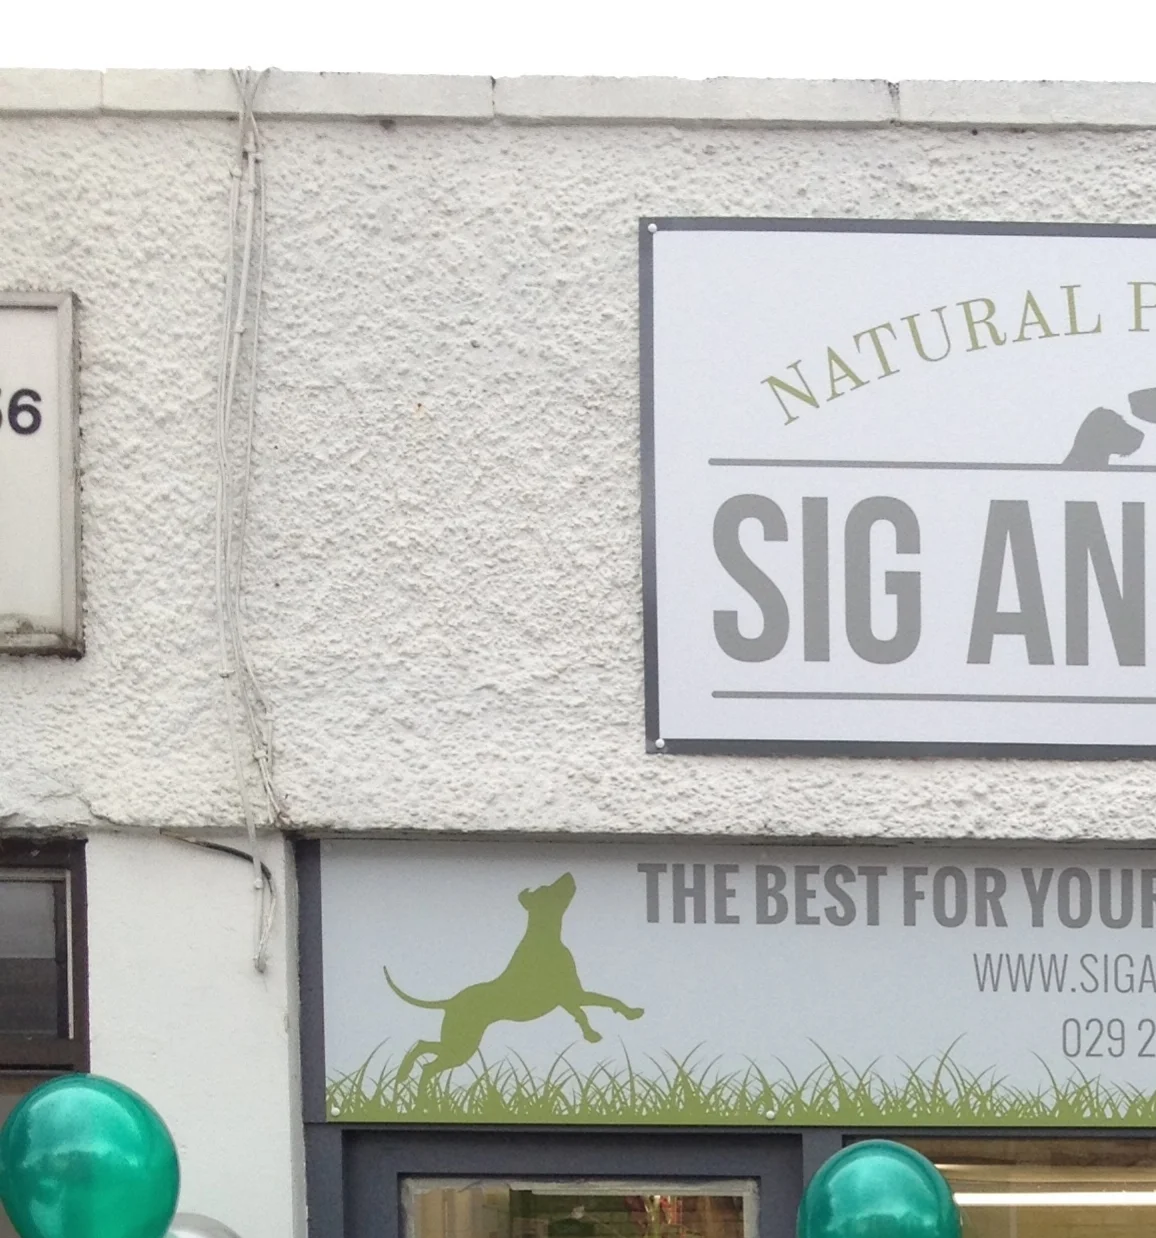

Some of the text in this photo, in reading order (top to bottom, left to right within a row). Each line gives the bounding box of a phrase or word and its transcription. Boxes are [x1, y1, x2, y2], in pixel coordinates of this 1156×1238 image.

[761, 283, 1102, 426] NATURAL
[711, 493, 922, 666] SIG
[637, 863, 740, 925] THE
[755, 864, 888, 927] BEST
[904, 866, 1008, 928] FOR
[1061, 1018, 1126, 1059] 029
